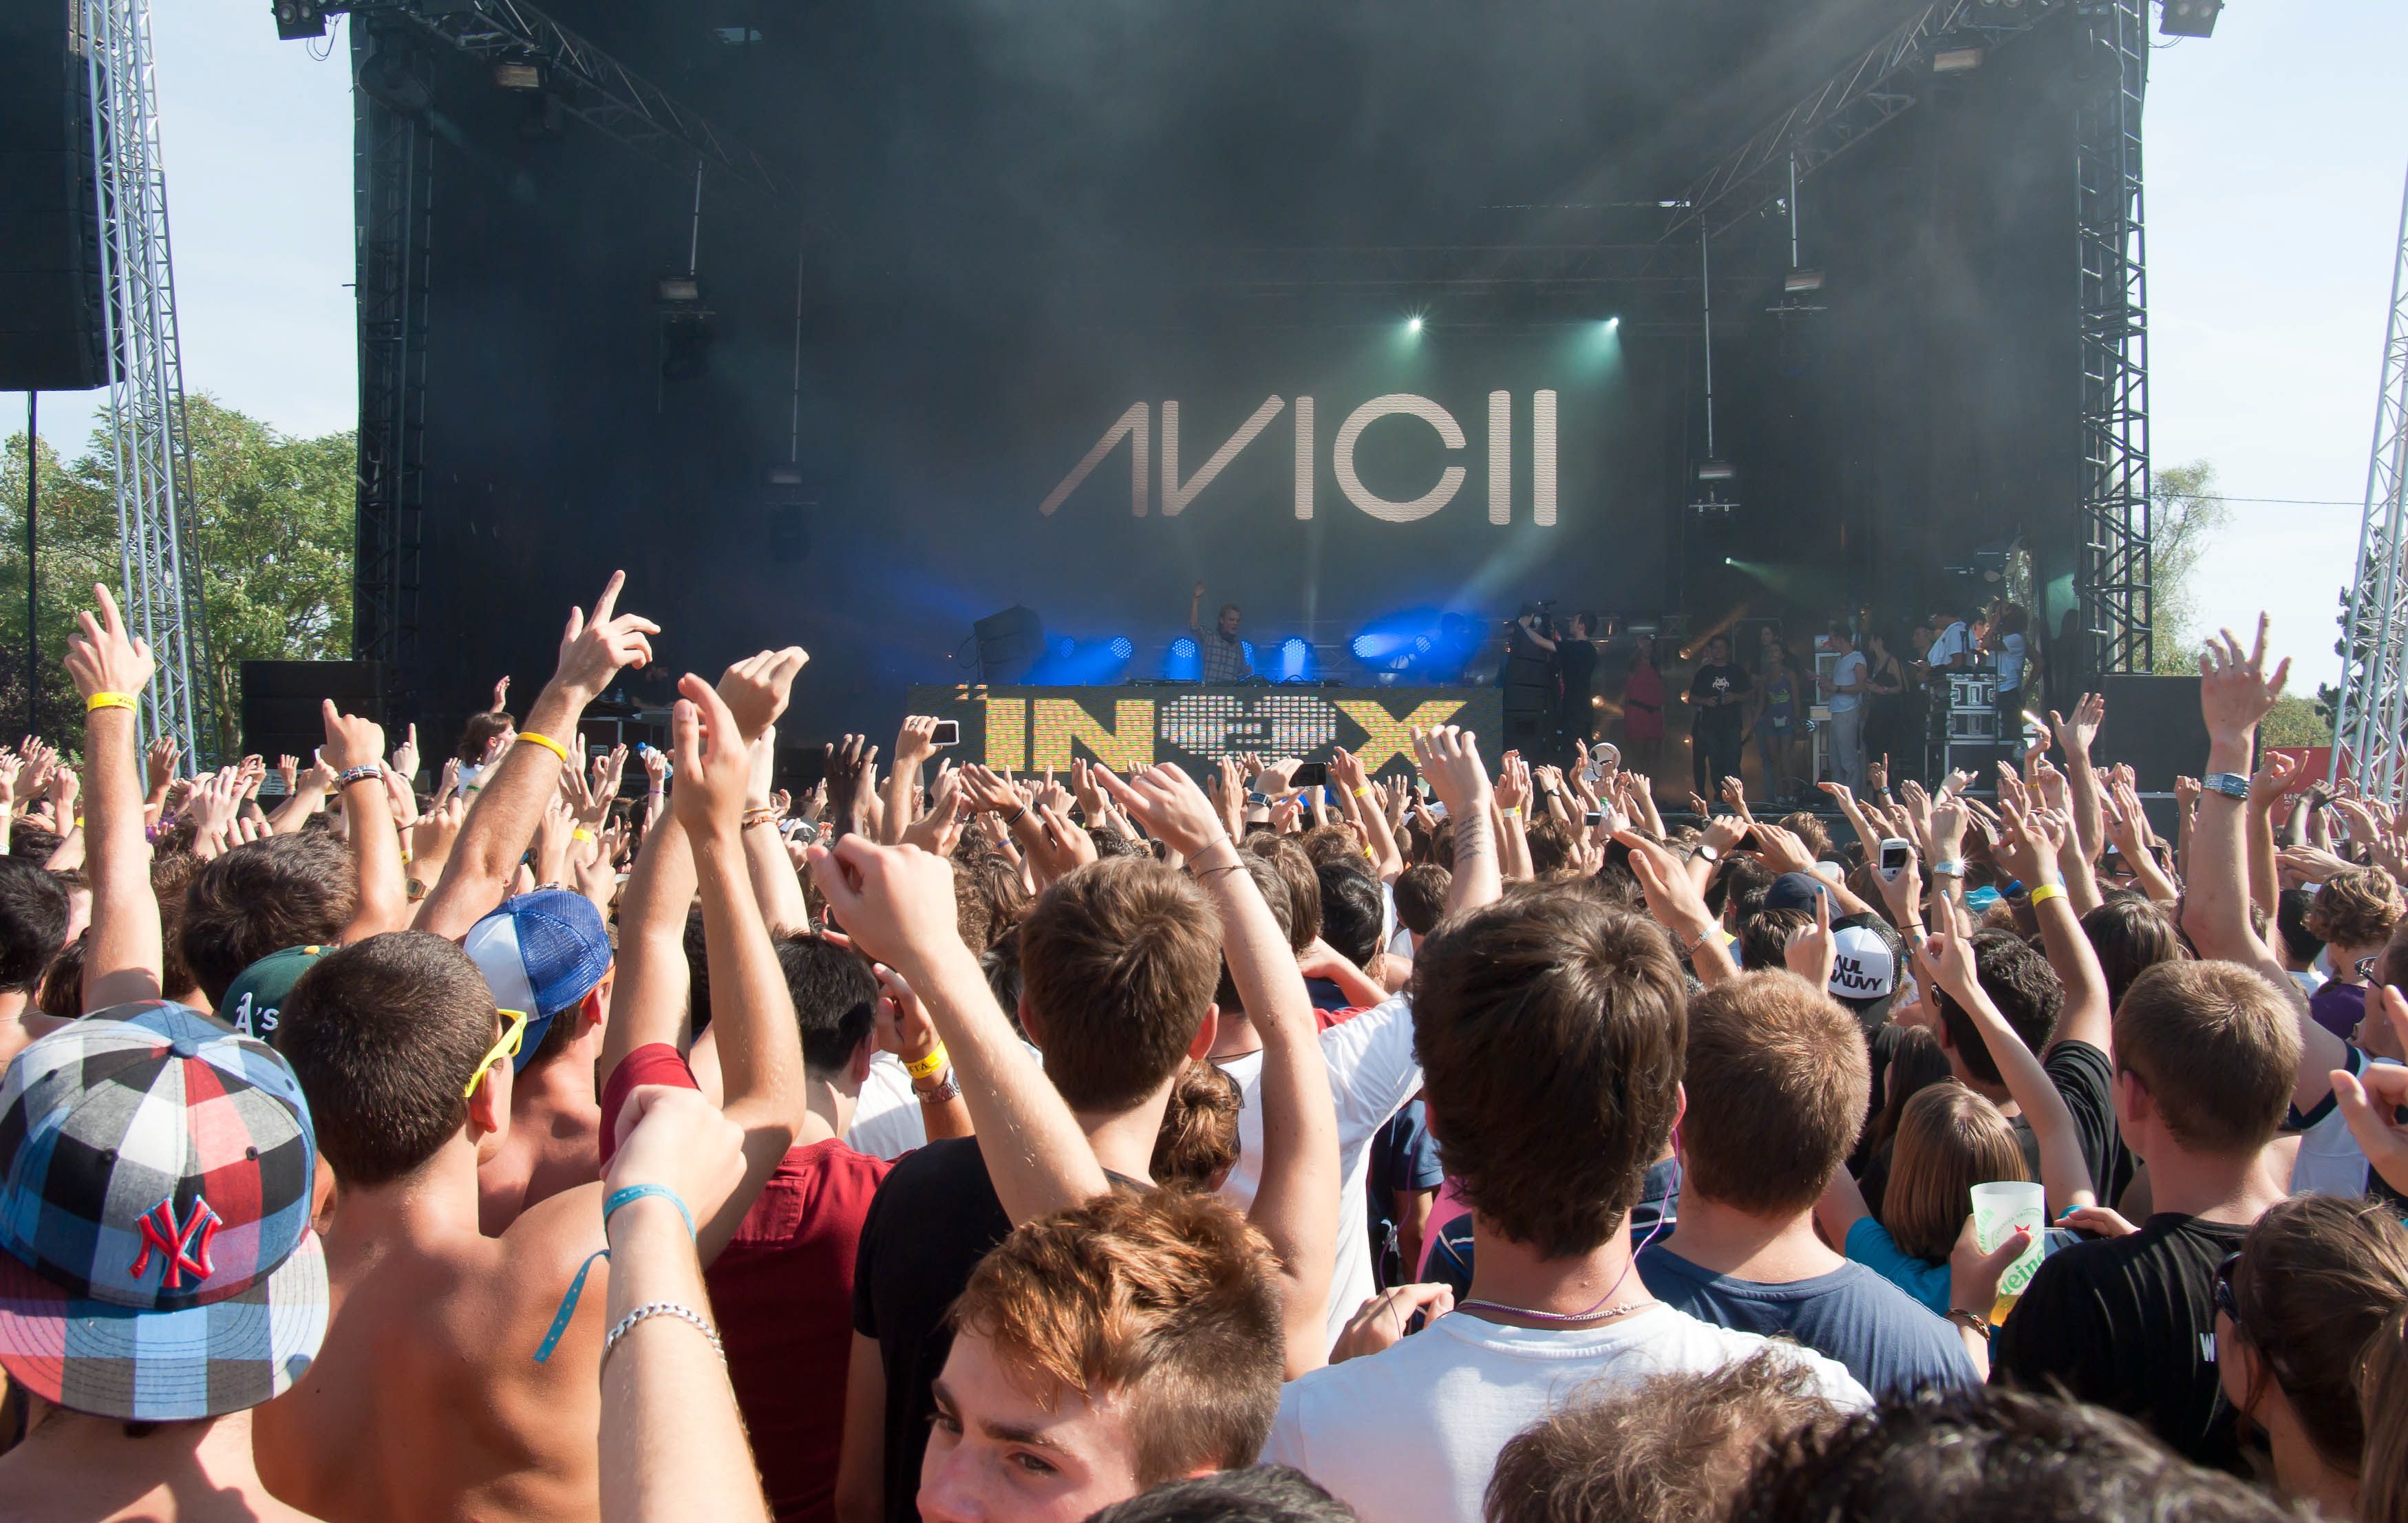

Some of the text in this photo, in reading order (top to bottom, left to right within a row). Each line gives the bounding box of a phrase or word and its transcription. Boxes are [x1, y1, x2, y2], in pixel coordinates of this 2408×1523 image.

[1038, 389, 1557, 526] AVICII
[1834, 954, 1863, 976] AUL
[129, 1194, 223, 1288] NY
